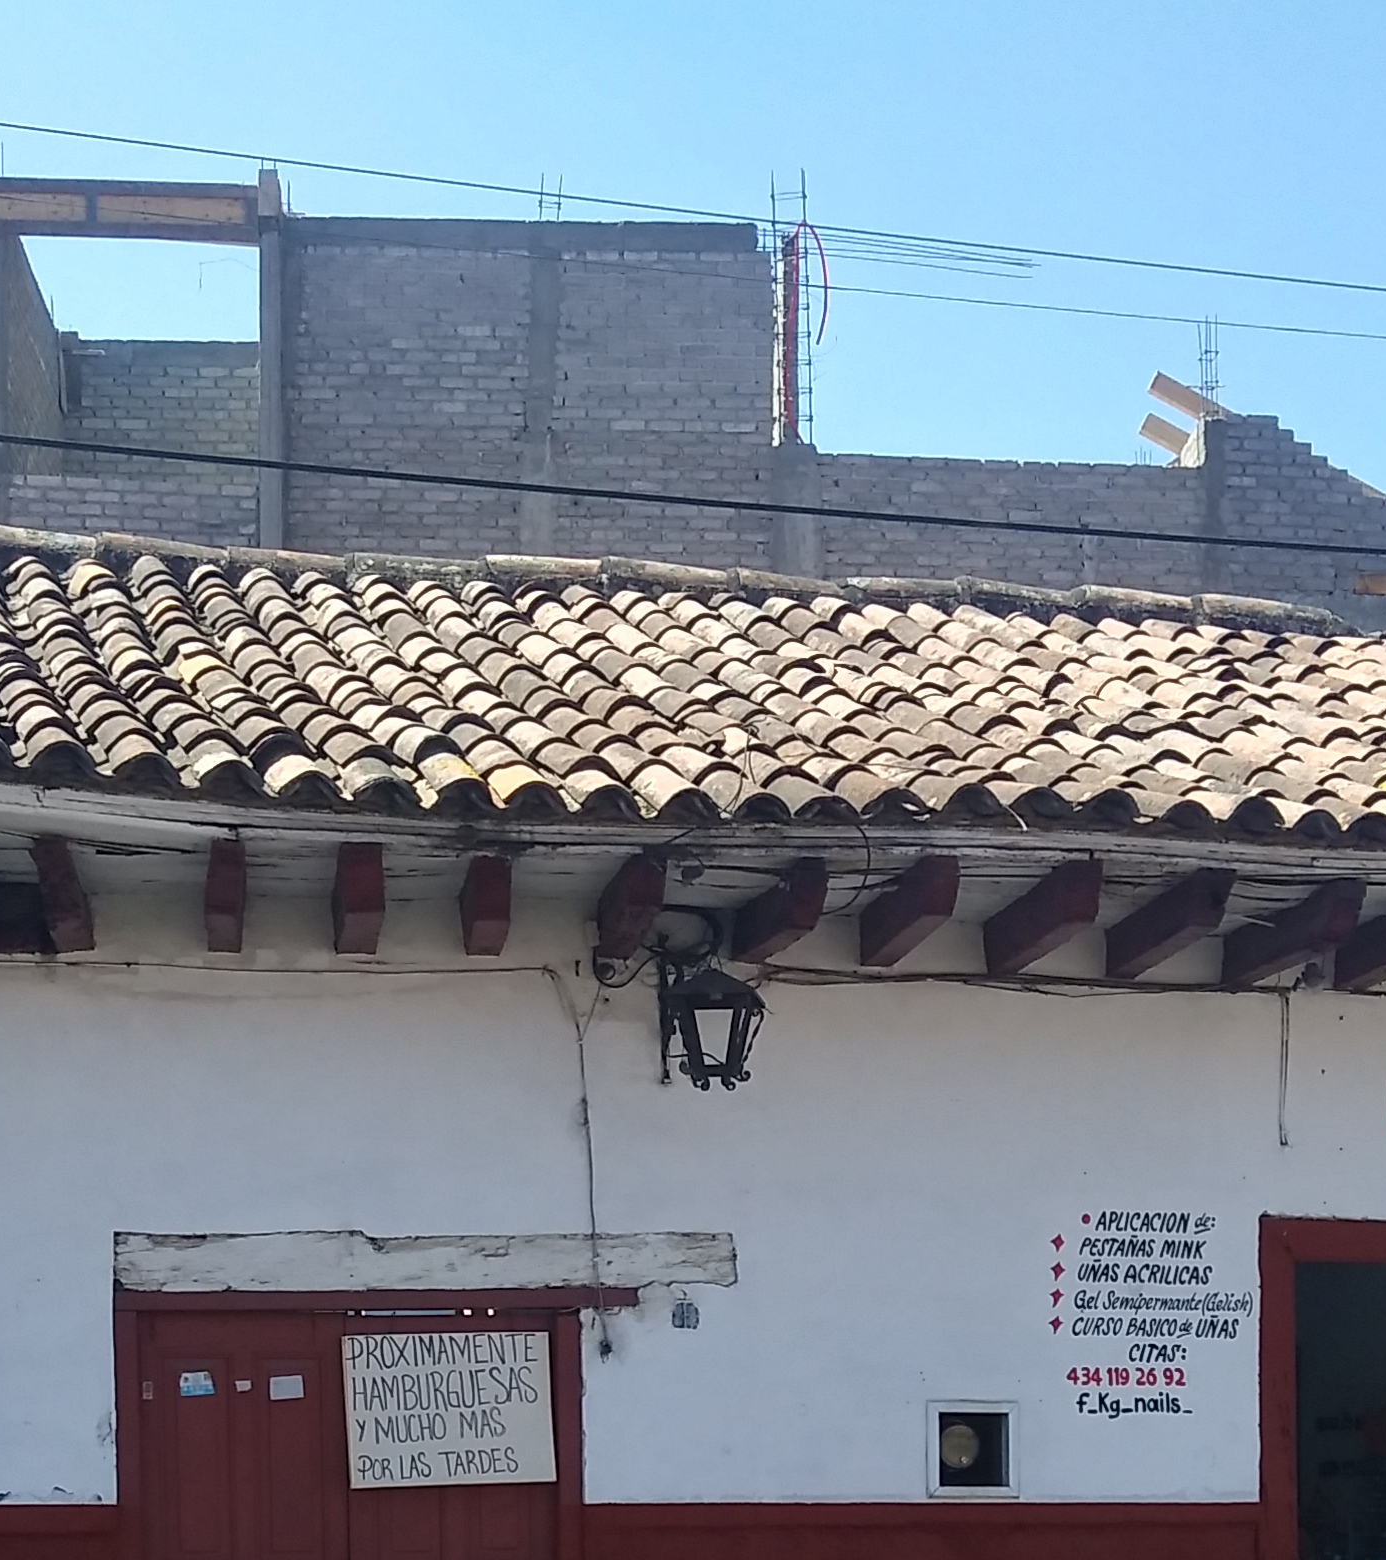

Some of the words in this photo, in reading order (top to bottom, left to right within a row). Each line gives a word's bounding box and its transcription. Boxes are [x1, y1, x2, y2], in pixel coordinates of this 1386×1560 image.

[1095, 1211, 1190, 1233] APLICACION
[1079, 1235, 1155, 1258] PESTAÑAS
[1159, 1239, 1207, 1259] MINK
[1077, 1259, 1120, 1283] UÑAS
[1123, 1263, 1213, 1285] ACRILICAS
[1074, 1290, 1101, 1312] Gel
[1072, 1317, 1123, 1337] CURSO
[1125, 1317, 1178, 1337] BASICO
[1176, 1318, 1193, 1338] de
[1195, 1315, 1239, 1339] UÑAS
[346, 1333, 539, 1371] PROXIMAMENTE
[1128, 1344, 1187, 1363] CITAS:
[352, 1365, 539, 1411] HAMBURGUESAS
[1066, 1367, 1103, 1386] 434
[1106, 1367, 1130, 1387] 119
[1135, 1367, 1158, 1386] 26
[1163, 1367, 1186, 1387] 92
[375, 1413, 447, 1445] MUCHO
[460, 1406, 507, 1439] MAS
[357, 1454, 394, 1482] POR
[399, 1451, 432, 1480] LAS
[438, 1447, 519, 1478] TARDES
